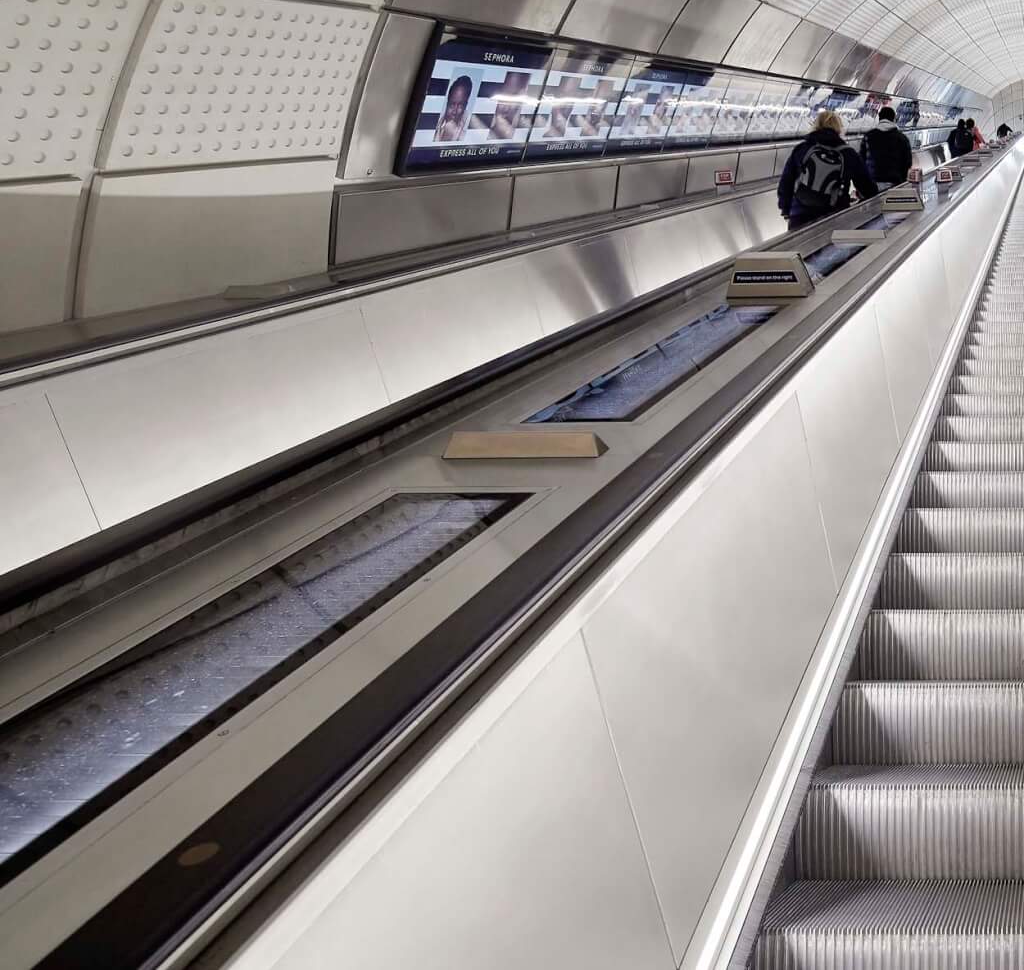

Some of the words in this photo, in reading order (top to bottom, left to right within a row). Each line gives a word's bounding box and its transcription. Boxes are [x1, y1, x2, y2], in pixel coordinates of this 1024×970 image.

[484, 52, 515, 63] SEPHORA
[439, 148, 466, 158] EXPRESS
[467, 148, 477, 156] ALL
[487, 147, 500, 155] YOU
